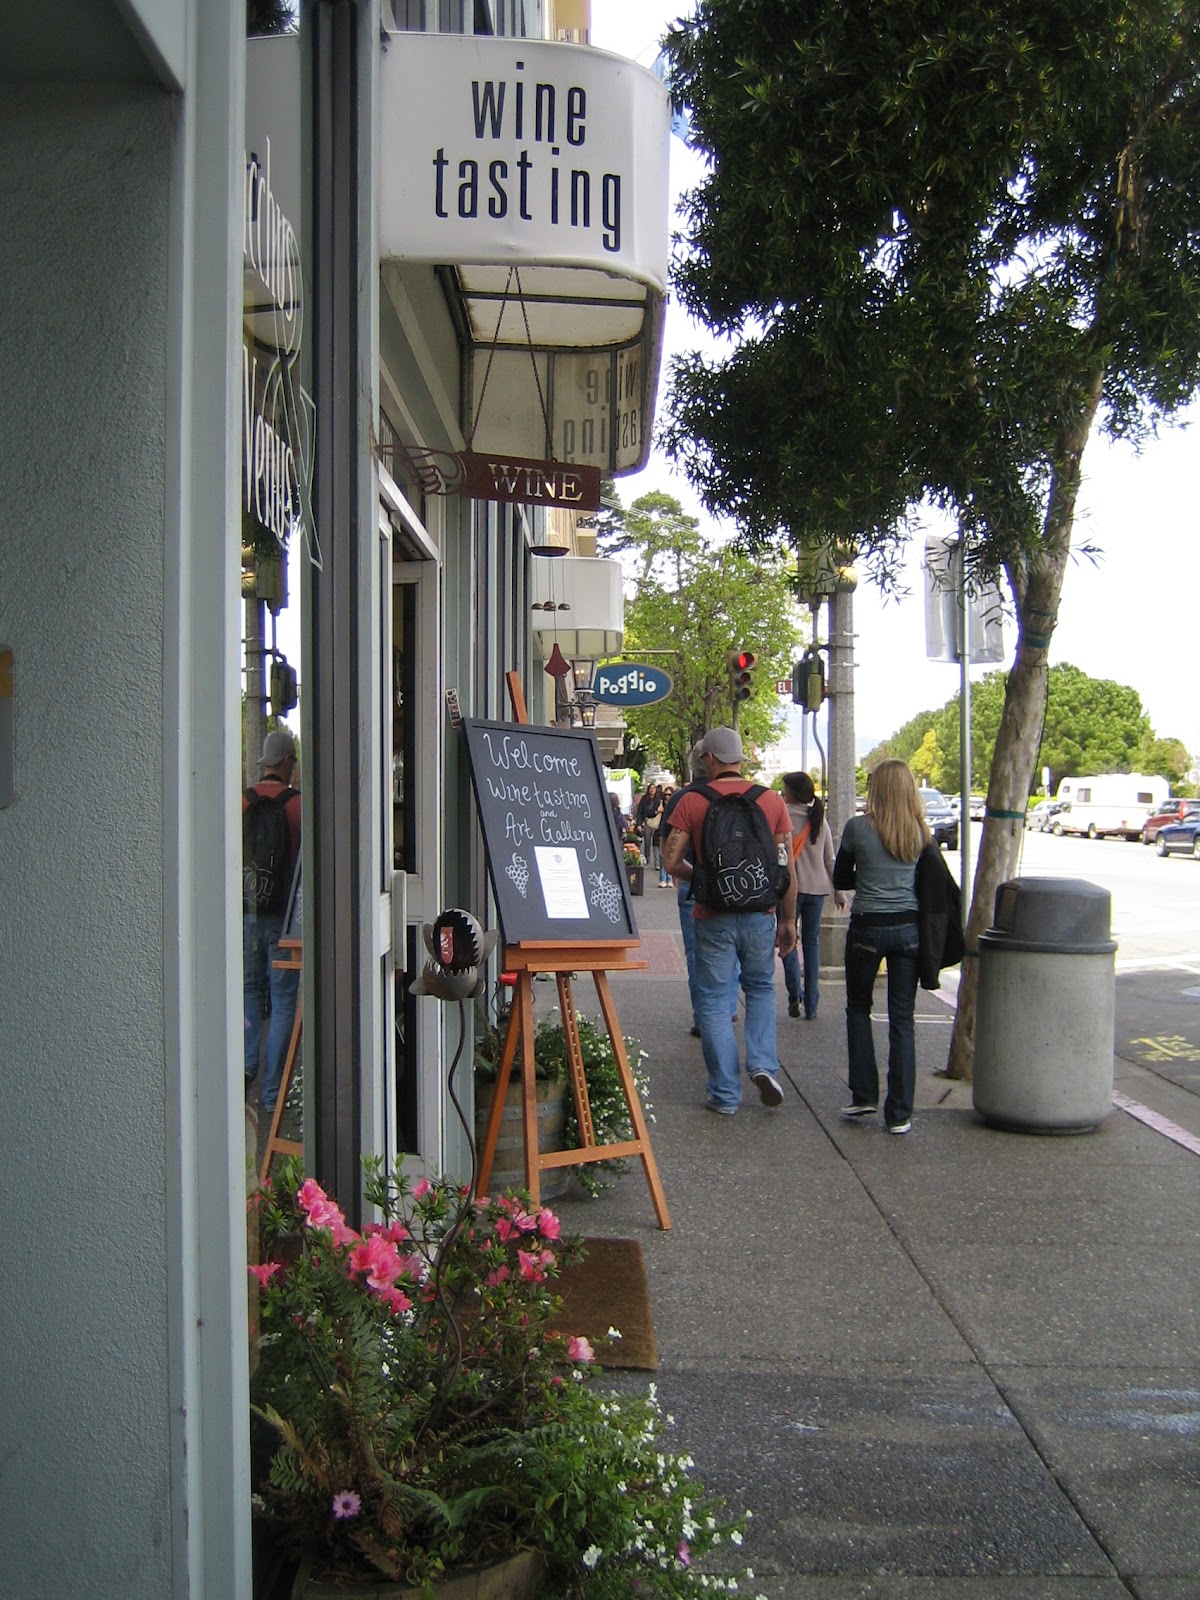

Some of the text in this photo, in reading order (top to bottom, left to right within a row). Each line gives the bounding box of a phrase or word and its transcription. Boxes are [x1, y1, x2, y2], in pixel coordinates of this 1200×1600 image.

[471, 61, 587, 146] wine
[432, 147, 622, 253] tasting
[243, 135, 294, 321] cchus
[242, 343, 294, 541] Venus
[488, 463, 583, 502] WINE
[600, 669, 657, 695] Poggio
[777, 681, 788, 693] EL
[483, 733, 581, 777] Welcome
[487, 777, 592, 819] Wine tasting
[540, 809, 558, 818] and
[505, 812, 598, 862] Art Gallery
